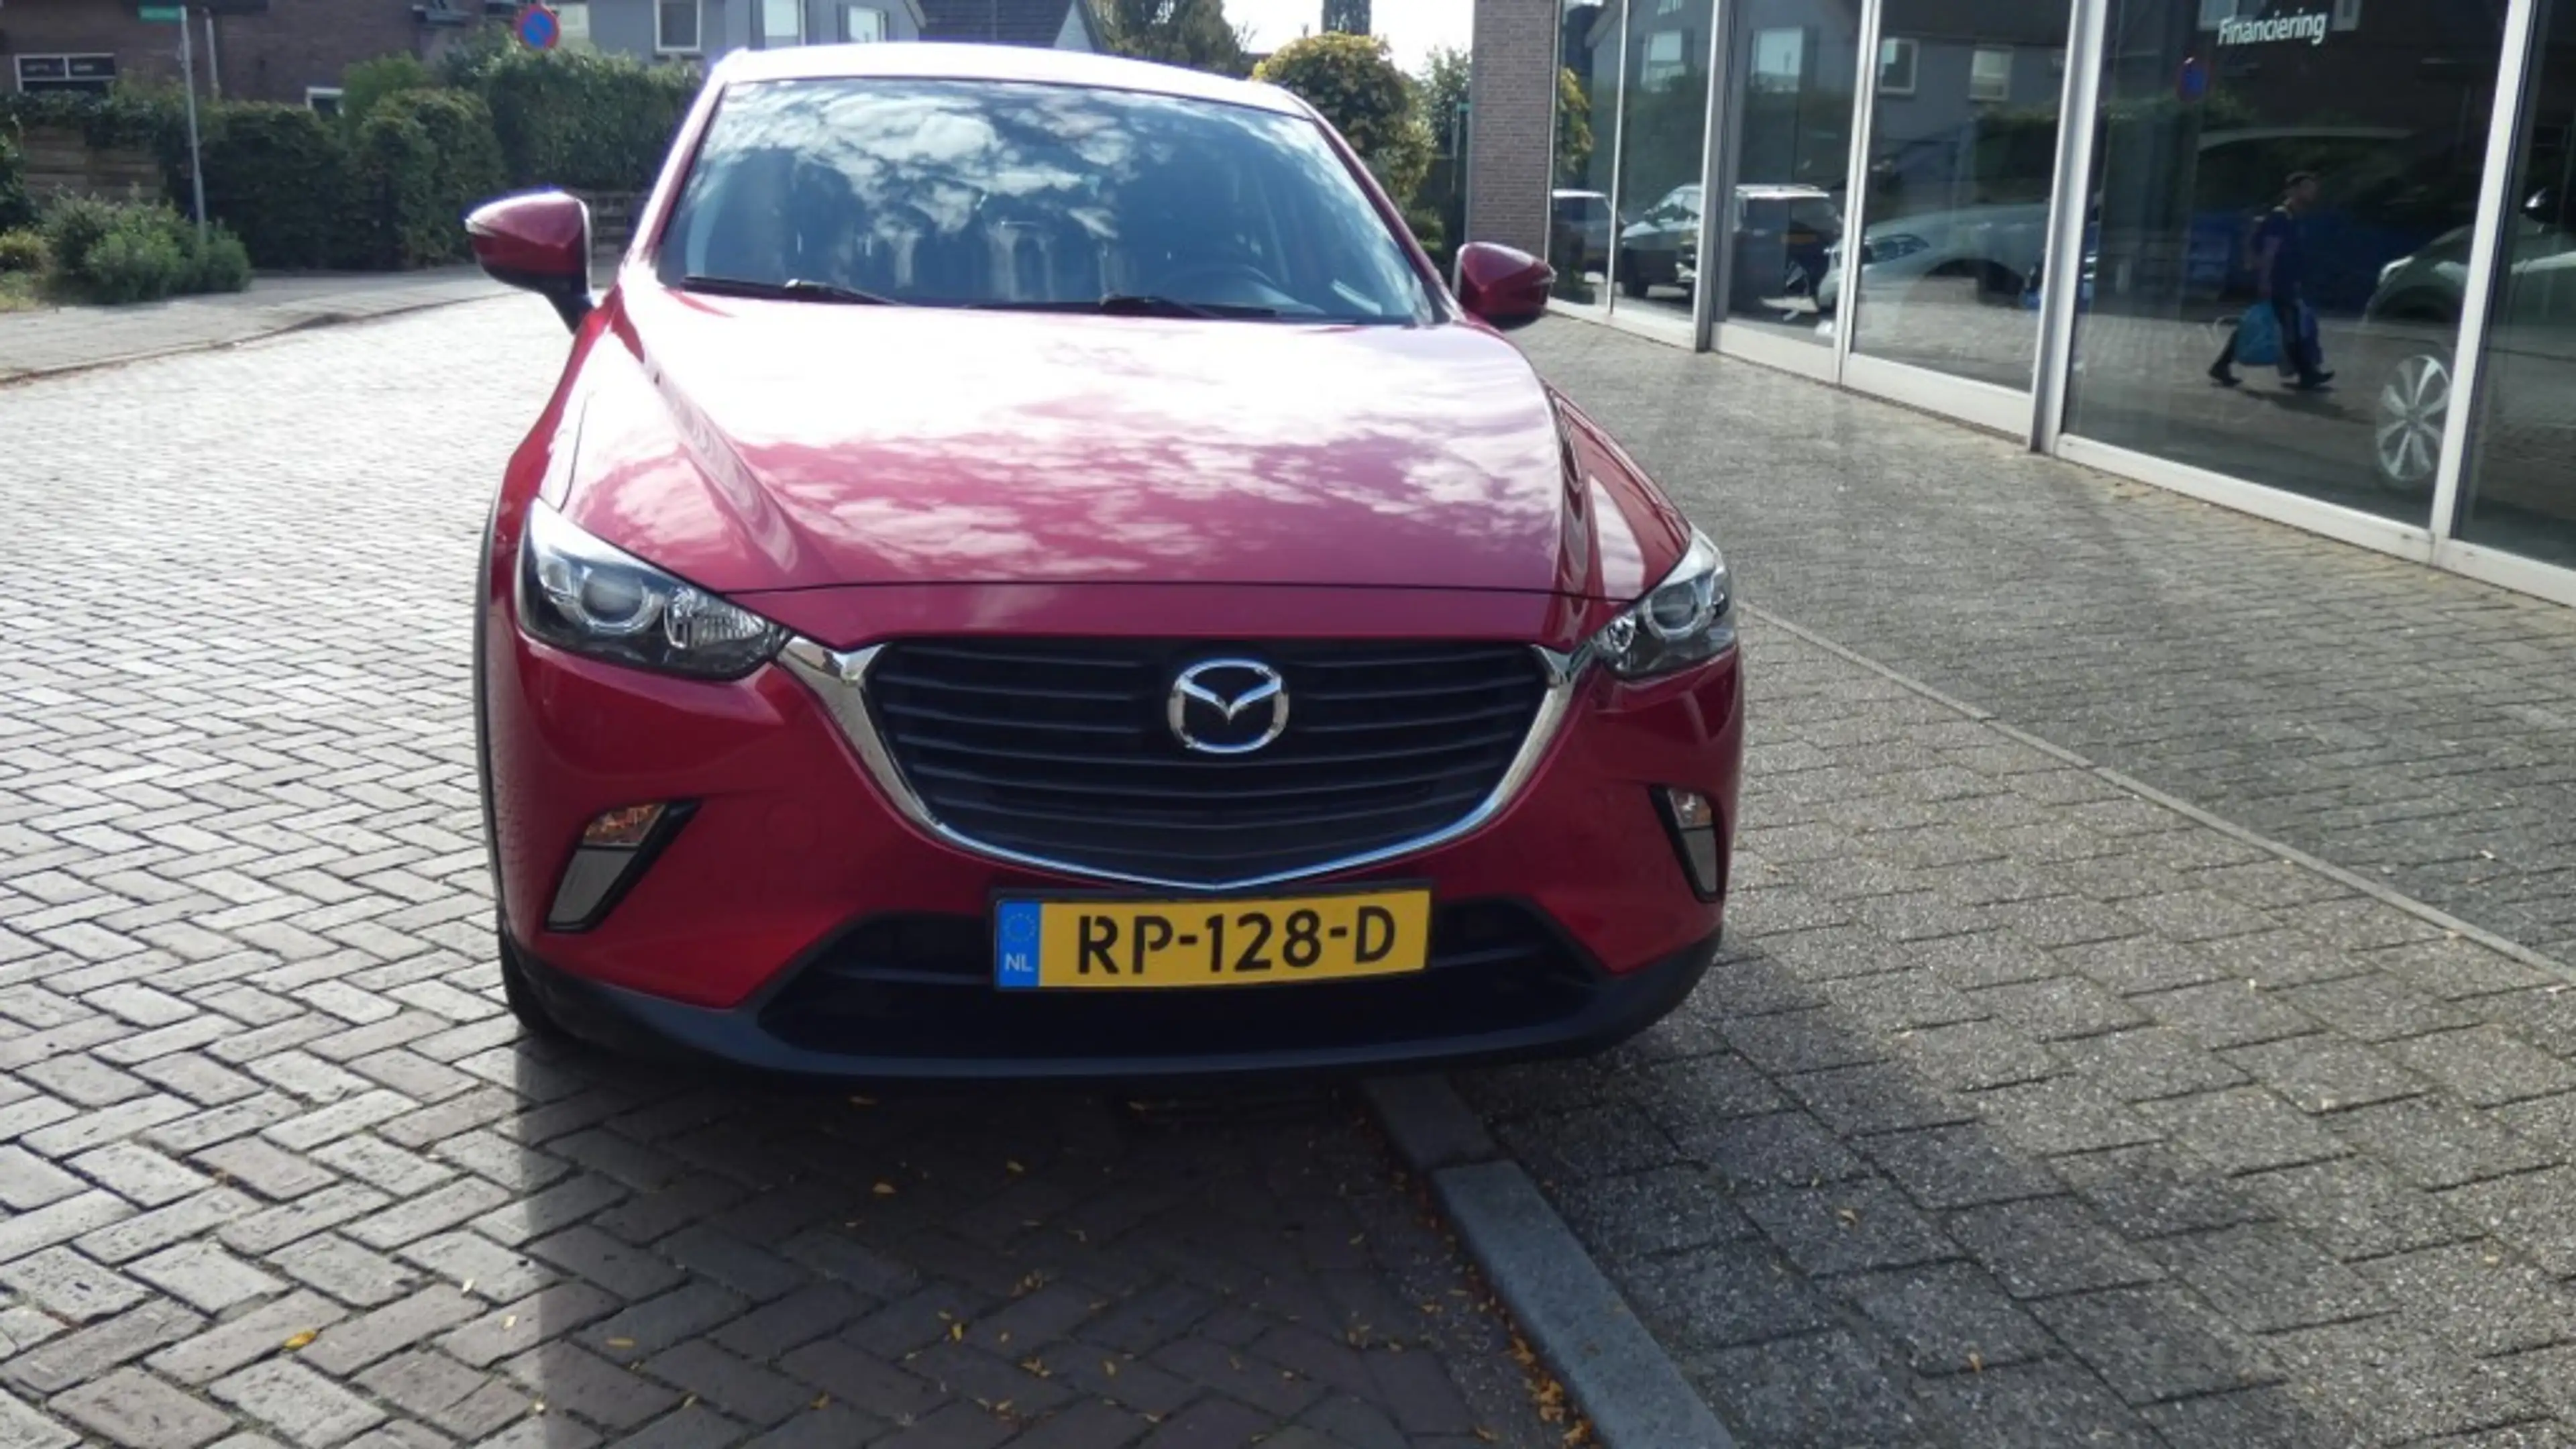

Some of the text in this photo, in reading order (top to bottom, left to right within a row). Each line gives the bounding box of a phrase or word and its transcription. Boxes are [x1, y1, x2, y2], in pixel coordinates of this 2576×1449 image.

[2218, 8, 2327, 45] Financiering
[1077, 906, 1395, 974] RP-128-D
[1005, 953, 1034, 972] NL
